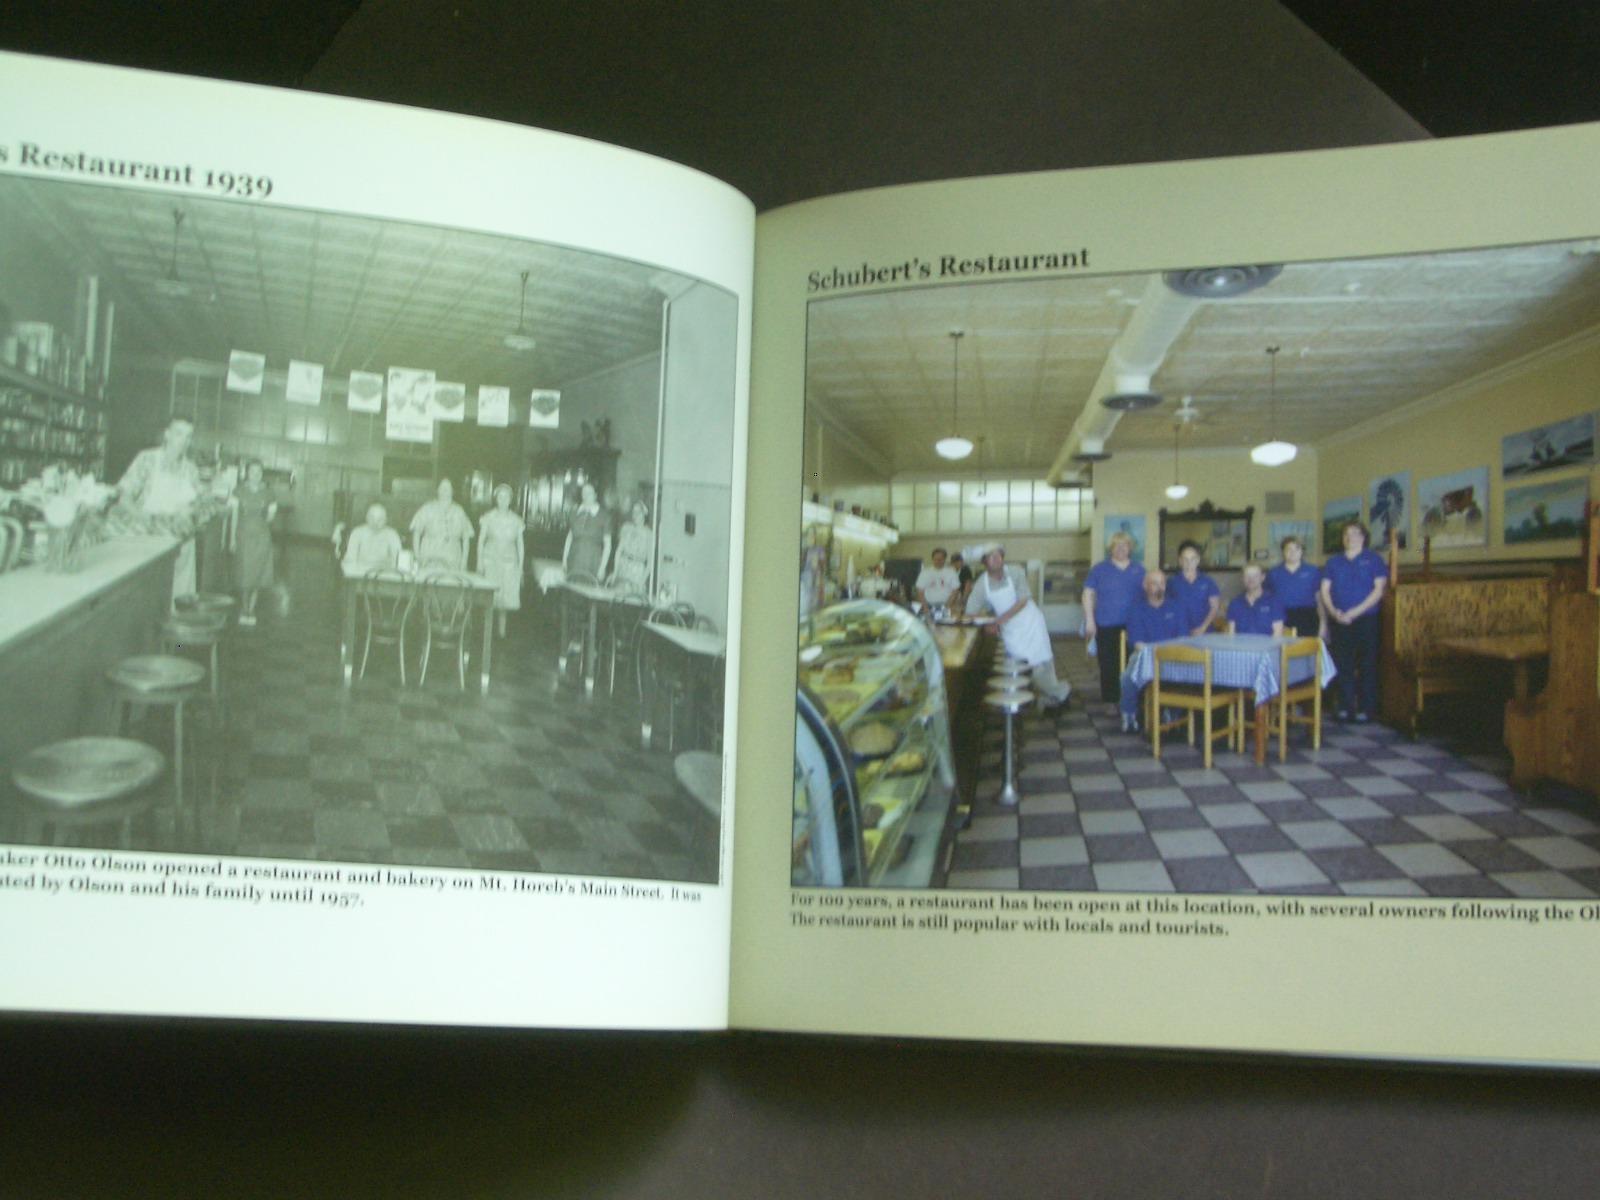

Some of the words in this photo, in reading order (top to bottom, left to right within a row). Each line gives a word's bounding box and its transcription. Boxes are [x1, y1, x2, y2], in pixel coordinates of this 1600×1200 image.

[20, 142, 193, 185] Restaurant
[206, 170, 274, 199] 1939
[807, 257, 931, 292] Schubert's
[939, 247, 1090, 278] Restaurant
[42, 874, 61, 895] by
[69, 877, 124, 893] Olson
[130, 880, 166, 895] and
[173, 881, 200, 897] his
[206, 883, 263, 903] family
[270, 887, 313, 903] until
[321, 891, 365, 908] 1957.
[44, 854, 86, 869] Otto
[92, 855, 146, 873] Olson
[153, 859, 222, 879] opened
[228, 866, 237, 877] a
[244, 865, 341, 881] restaurant
[348, 870, 381, 884] and
[387, 871, 447, 889] bakery
[452, 877, 474, 889] on
[479, 876, 506, 892] Mt.
[513, 877, 575, 894] Horeb's
[581, 881, 617, 897] Main
[621, 883, 664, 899] Street.
[671, 885, 679, 899] It
[683, 890, 701, 901] was
[790, 911, 815, 927] The
[819, 914, 896, 929] restaurant
[902, 914, 914, 928] is
[919, 914, 948, 929] still
[953, 914, 1019, 933] popular
[1023, 915, 1059, 931] with
[1064, 916, 1114, 933] locals
[1119, 918, 1151, 934] and
[1155, 919, 1230, 936] tourists.
[791, 892, 814, 907] For
[819, 895, 843, 907] 100
[848, 895, 892, 910] years,
[897, 897, 905, 908] a
[910, 896, 994, 910] restaurant
[1000, 897, 1028, 911] has
[1033, 898, 1074, 912] been
[1078, 901, 1122, 915] open
[1125, 901, 1140, 913] at
[1146, 899, 1179, 914] this
[1184, 899, 1261, 918] location,
[1267, 901, 1304, 916] with
[1310, 901, 1374, 918] several
[1379, 906, 1446, 919] owners
[1451, 903, 1540, 923] following
[1545, 904, 1574, 920] the
